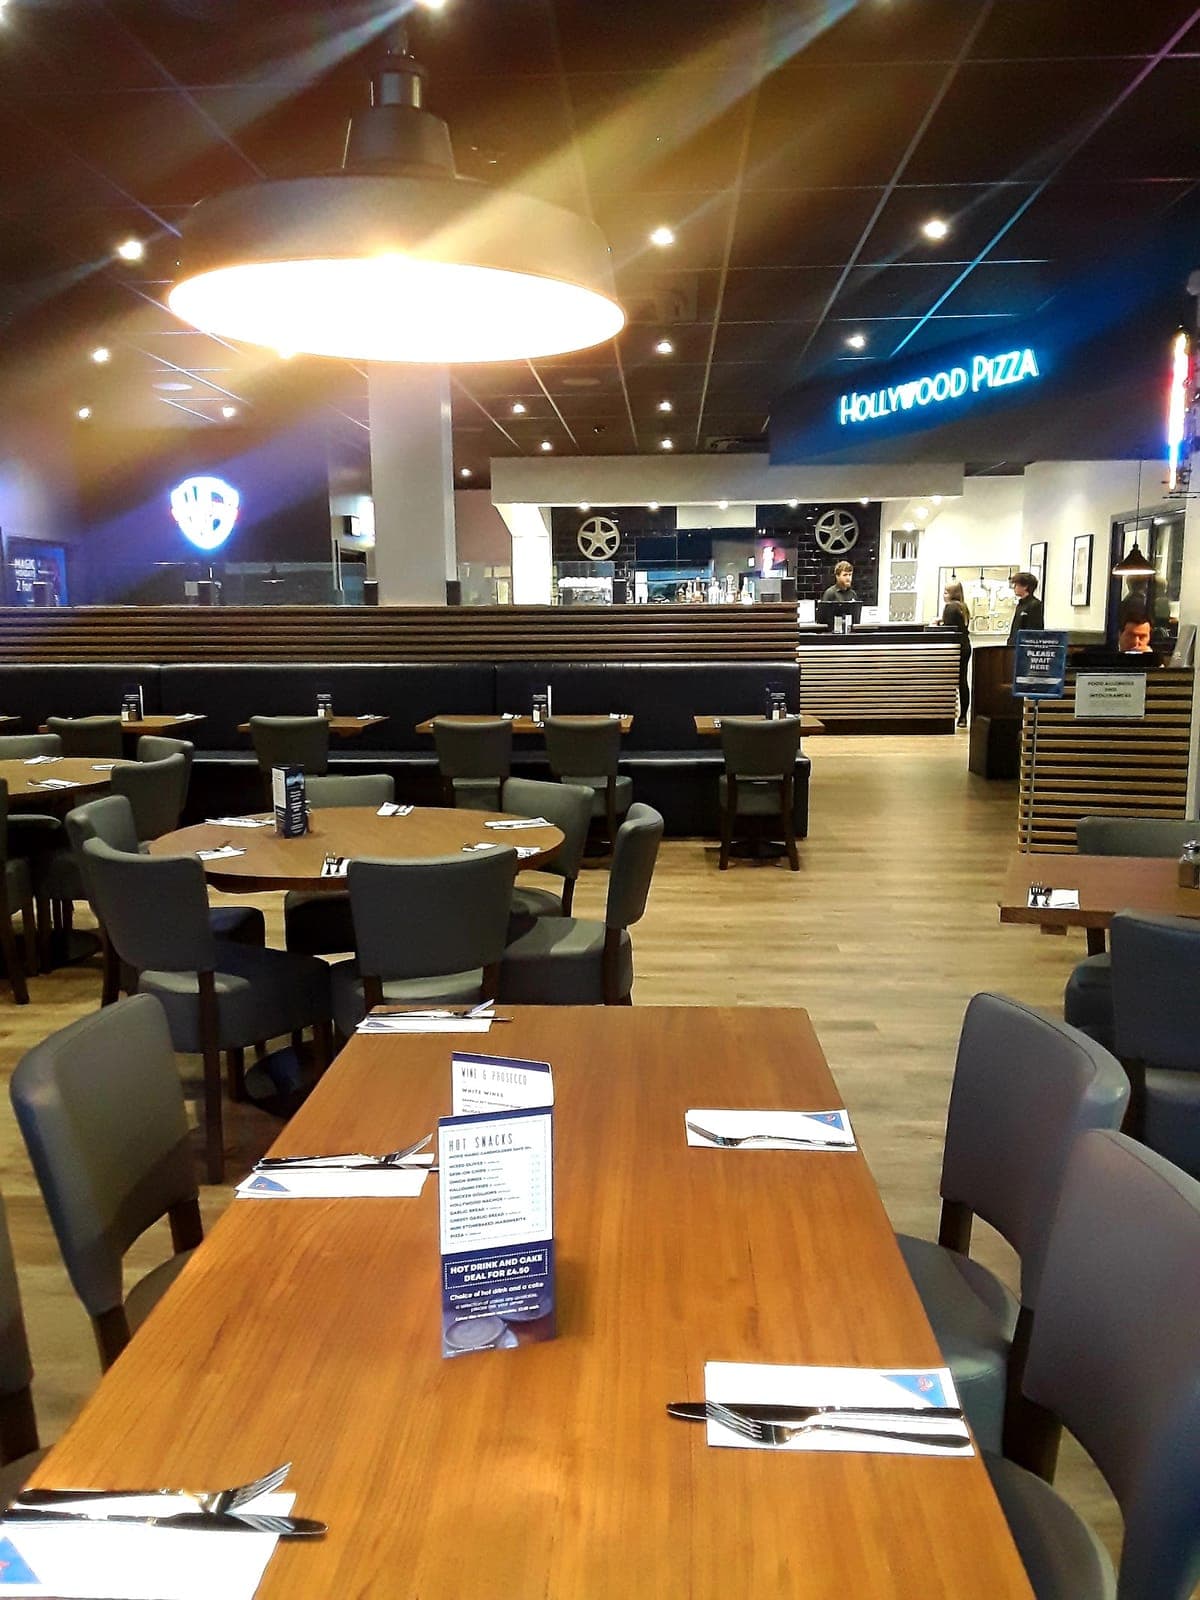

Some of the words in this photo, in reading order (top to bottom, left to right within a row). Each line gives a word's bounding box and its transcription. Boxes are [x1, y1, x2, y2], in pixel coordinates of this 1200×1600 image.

[971, 348, 1040, 392] PIZZA
[1026, 650, 1057, 658] PLEASE
[1030, 663, 1050, 671] HERE
[492, 1071, 528, 1086] PROSECCO
[450, 1138, 467, 1152] HOT
[476, 1134, 514, 1149] SNACKS
[451, 1265, 470, 1275] HOT
[471, 1261, 499, 1272] DRINK
[500, 1258, 518, 1268] AND
[520, 1255, 543, 1265] CAKE
[464, 1273, 487, 1283] DEAL
[488, 1270, 506, 1279] FOR
[450, 1293, 472, 1301] Choice
[482, 1289, 492, 1297] hot
[493, 1287, 508, 1295] drink
[528, 1282, 544, 1290] cake
